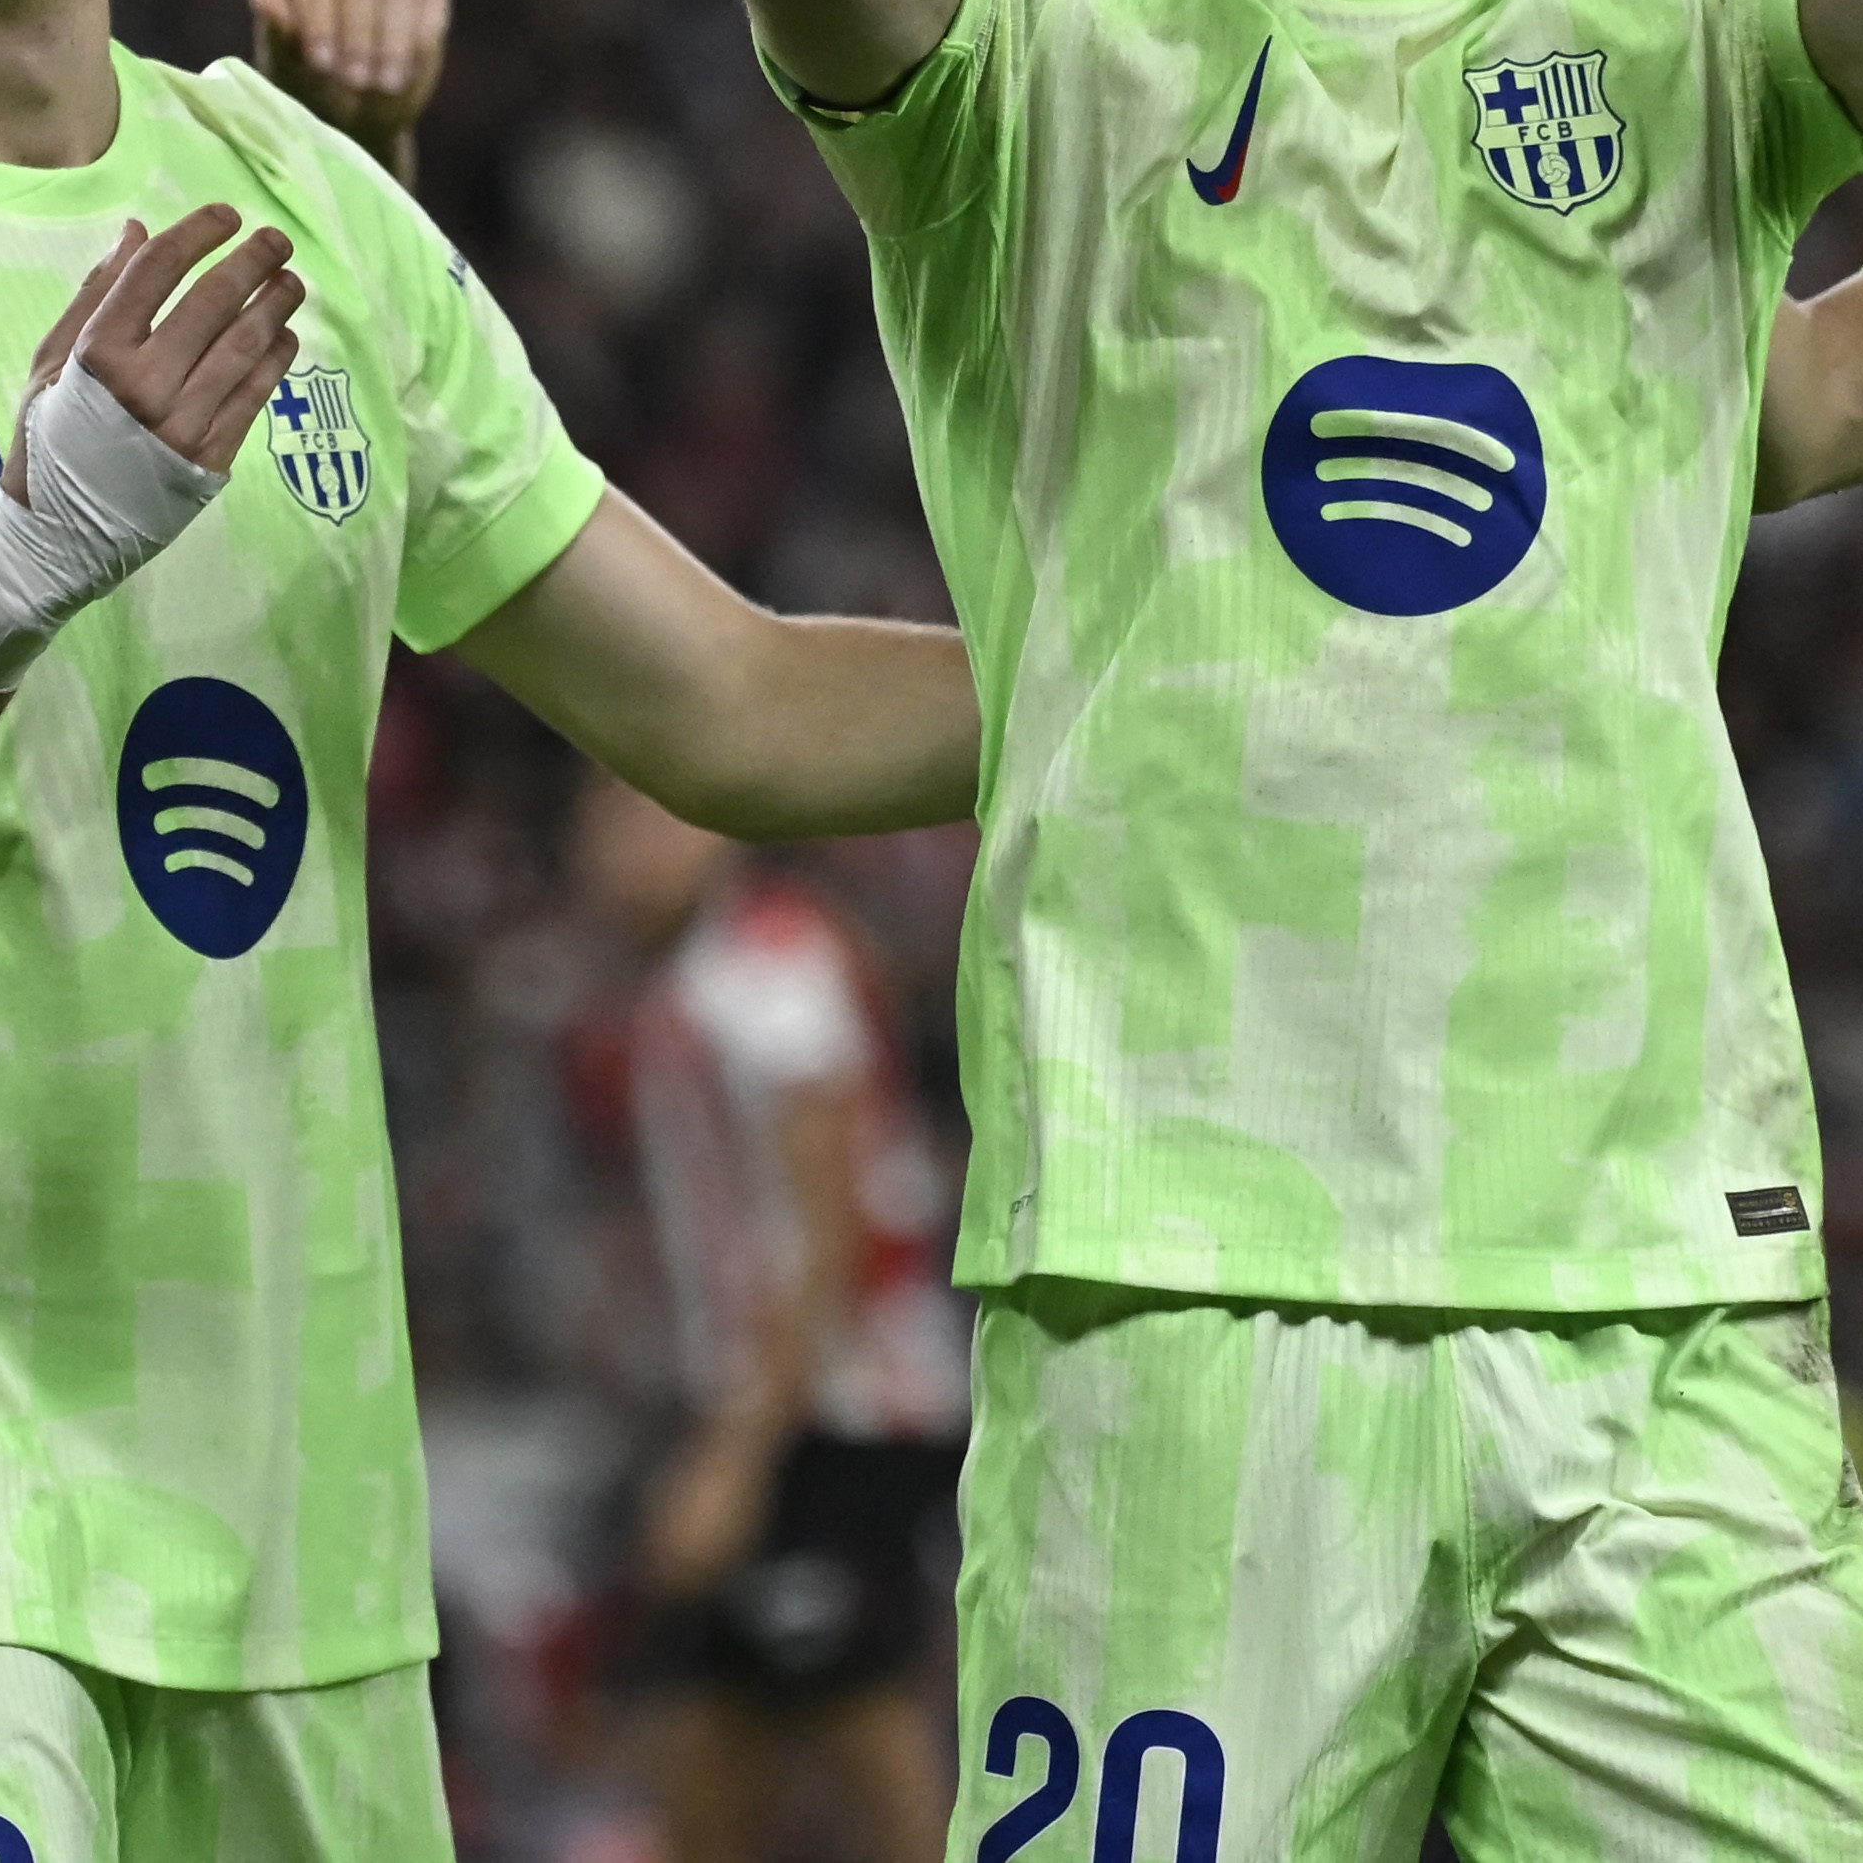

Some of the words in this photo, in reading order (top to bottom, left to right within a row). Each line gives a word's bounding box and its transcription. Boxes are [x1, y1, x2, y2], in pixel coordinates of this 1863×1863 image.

[1518, 121, 1573, 143] FCB
[300, 432, 338, 450] FCB
[976, 1695, 1226, 1863] 20
